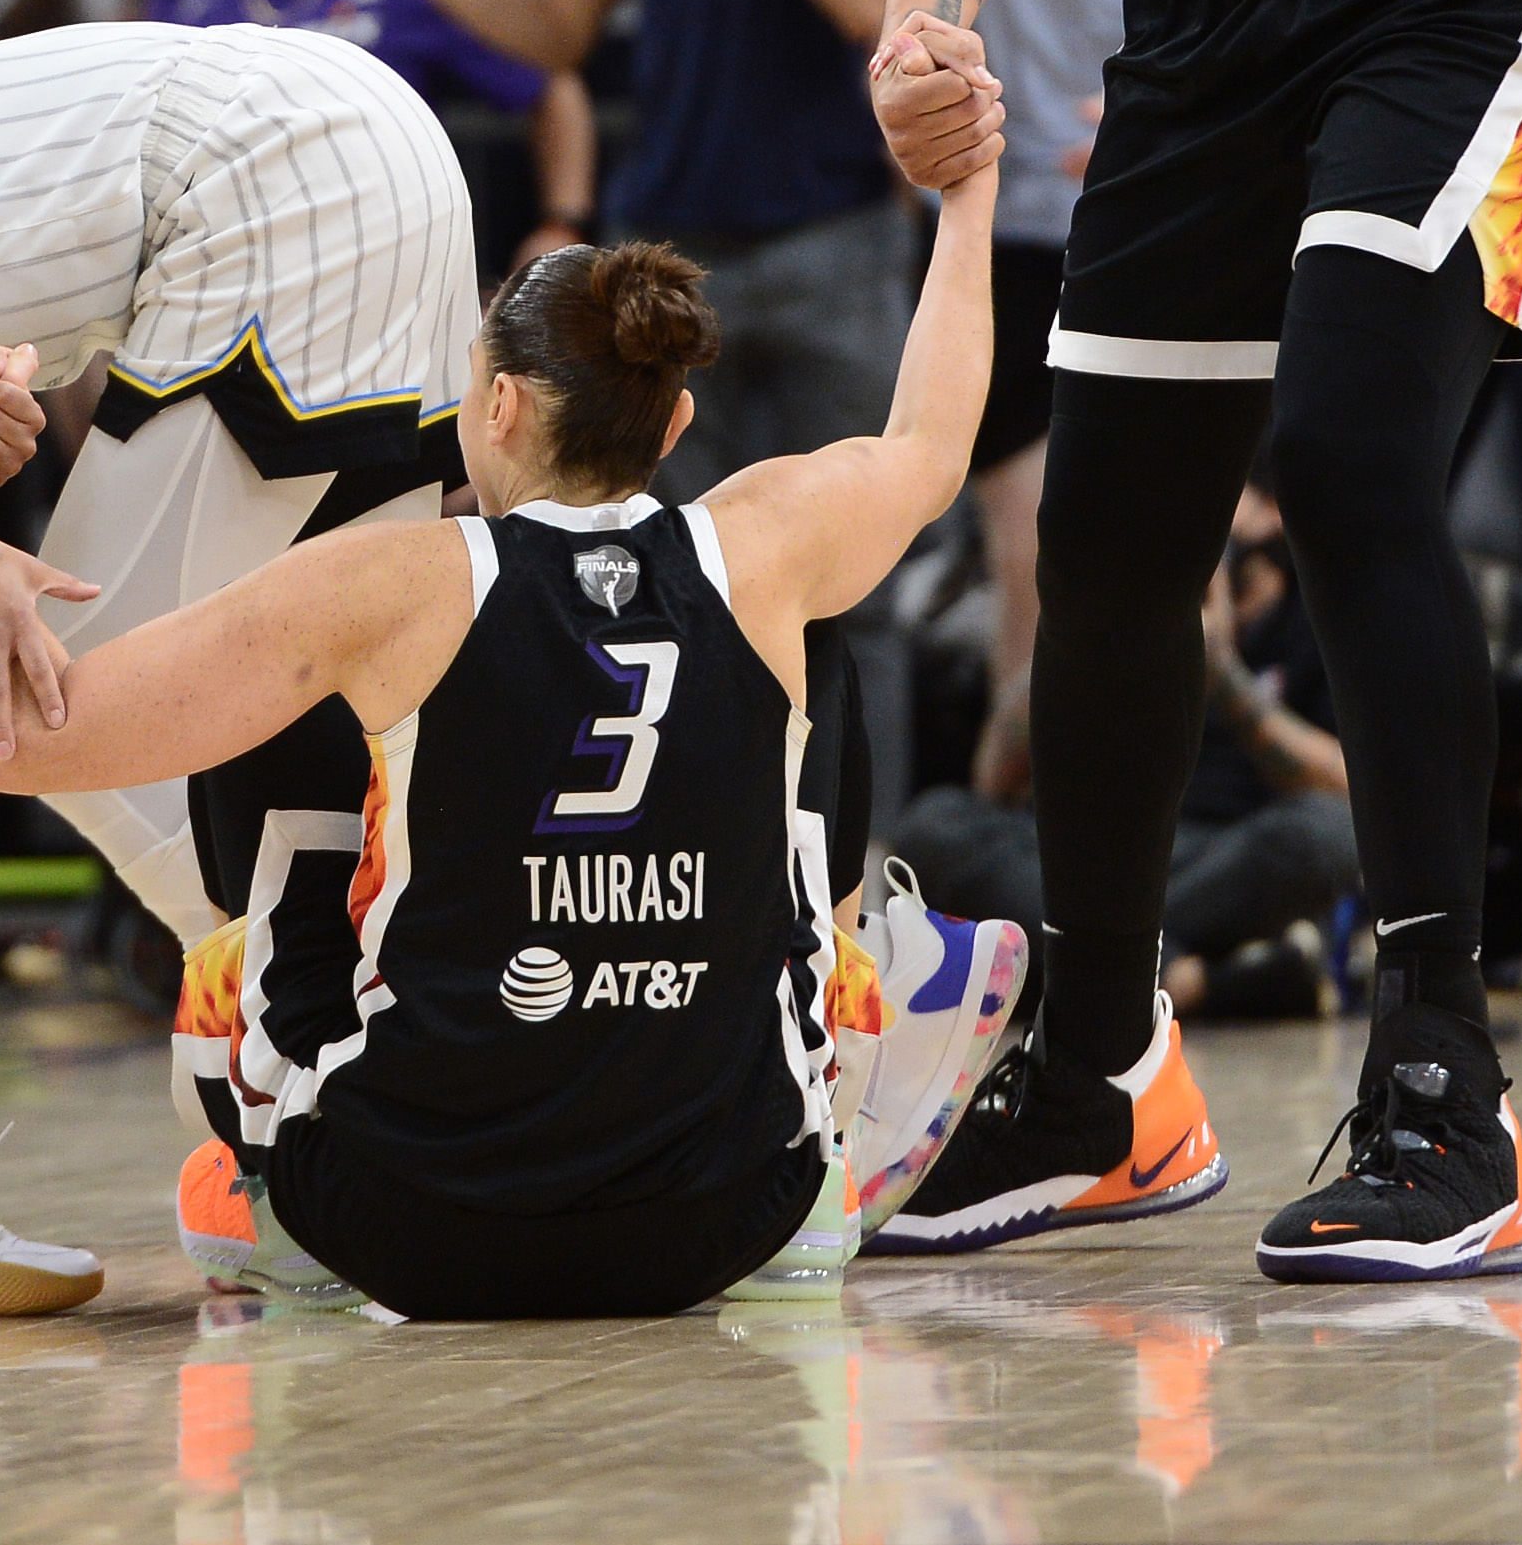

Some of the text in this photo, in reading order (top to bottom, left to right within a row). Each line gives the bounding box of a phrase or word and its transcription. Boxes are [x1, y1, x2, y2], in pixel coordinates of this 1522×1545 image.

[577, 560, 638, 576] FINALS
[553, 641, 679, 815] 3
[522, 851, 705, 924] TAURASI
[581, 959, 708, 1010] AT&T
